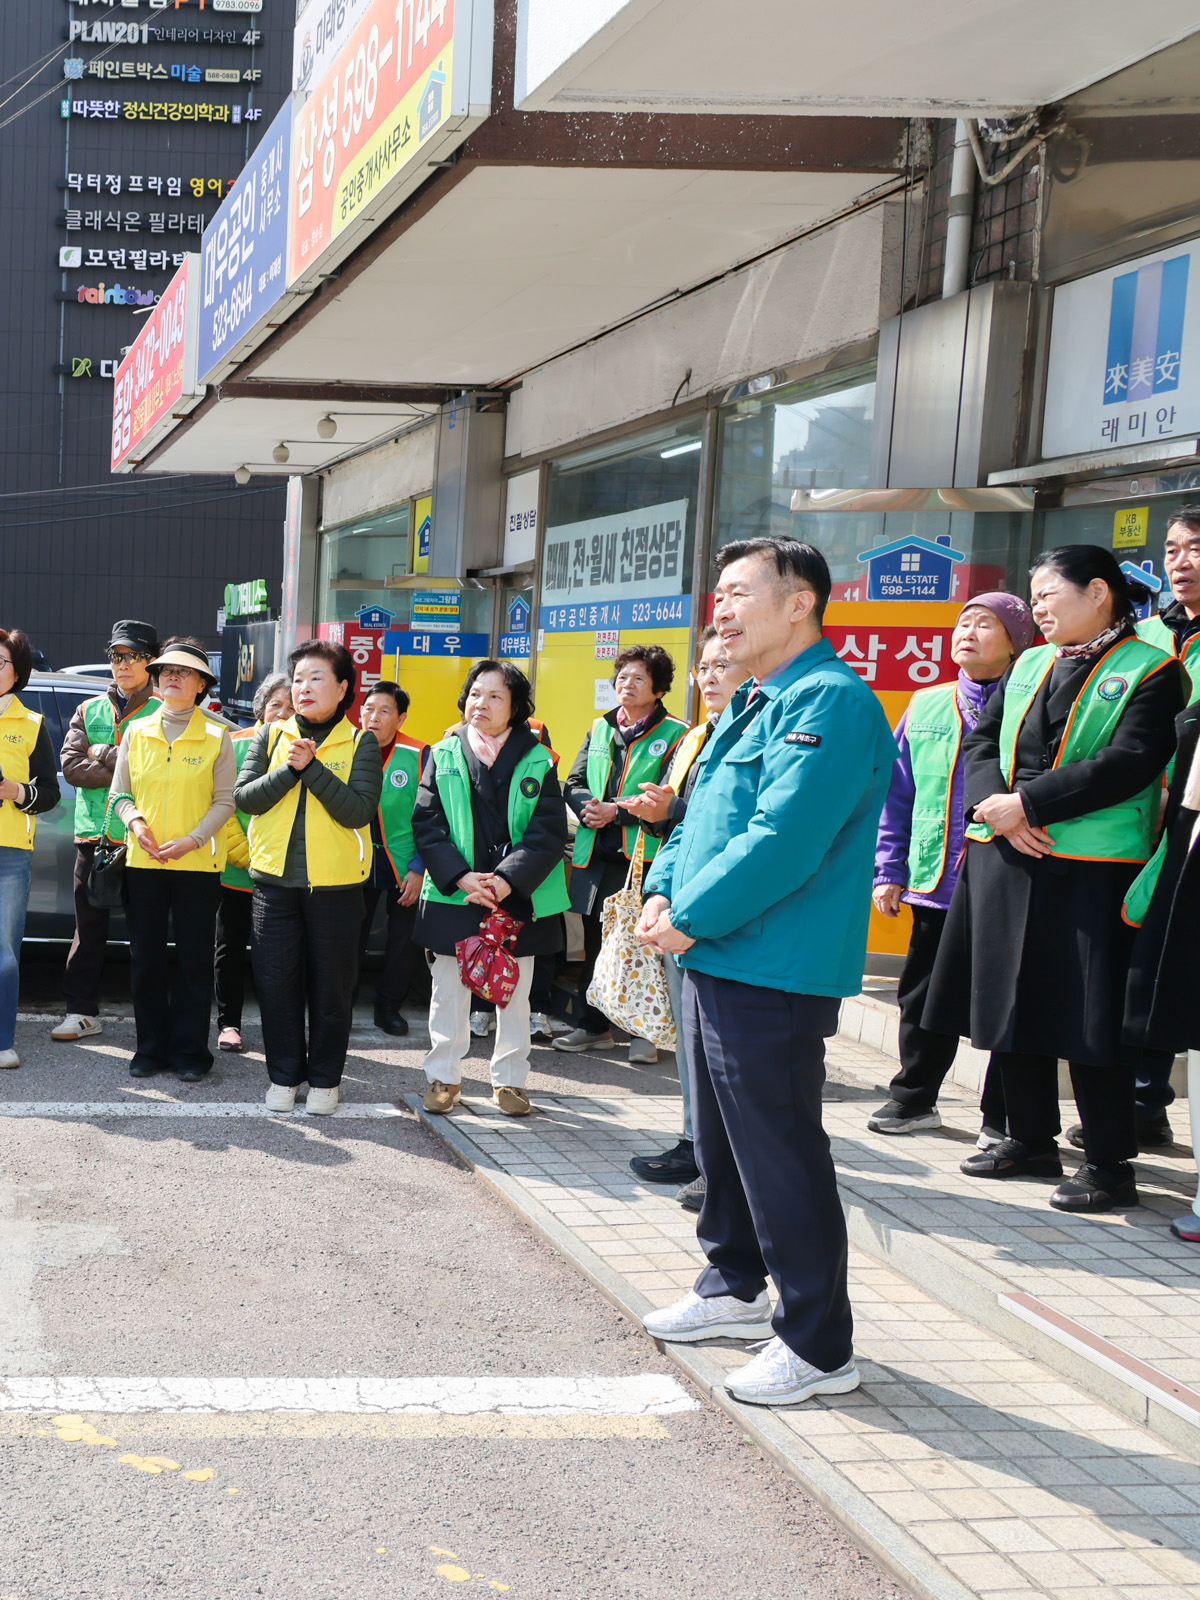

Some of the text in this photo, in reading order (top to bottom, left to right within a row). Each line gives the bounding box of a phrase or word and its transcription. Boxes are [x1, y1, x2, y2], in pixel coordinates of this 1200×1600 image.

[69, 20, 261, 45] PLAN201 인테리어 디자인 4F
[88, 60, 262, 83] 페인트박스 미술 588-0883 4F
[72, 100, 121, 119] 따뜻한
[123, 101, 230, 122] 정신건강의학과
[244, 108, 262, 121] 4F
[295, 74, 339, 219] 삼성
[261, 136, 285, 198] 중개사
[341, 115, 411, 220] 공인중개사사무소
[67, 173, 222, 197] 닥터정 프라임 영어
[259, 180, 282, 236] 사무소
[65, 209, 209, 234] 클래식온 필라테
[204, 171, 257, 310] 대우공인
[212, 268, 254, 352] 523-6644
[135, 278, 187, 400] 3472-0043
[1105, 350, 1180, 394] 來美安
[1101, 405, 1176, 443] 래미안
[509, 509, 537, 532] 친절상담
[1119, 525, 1142, 537] 부동산
[1125, 513, 1137, 524] KB
[619, 519, 681, 584] 친절상담
[880, 575, 939, 584] REAL ESTATE
[881, 585, 936, 595] 598-1144
[549, 601, 682, 628] 대우공인중개사 523-6644
[413, 635, 461, 654] 대우
[836, 634, 943, 683] 삼성
[797, 735, 817, 744] 서초구
